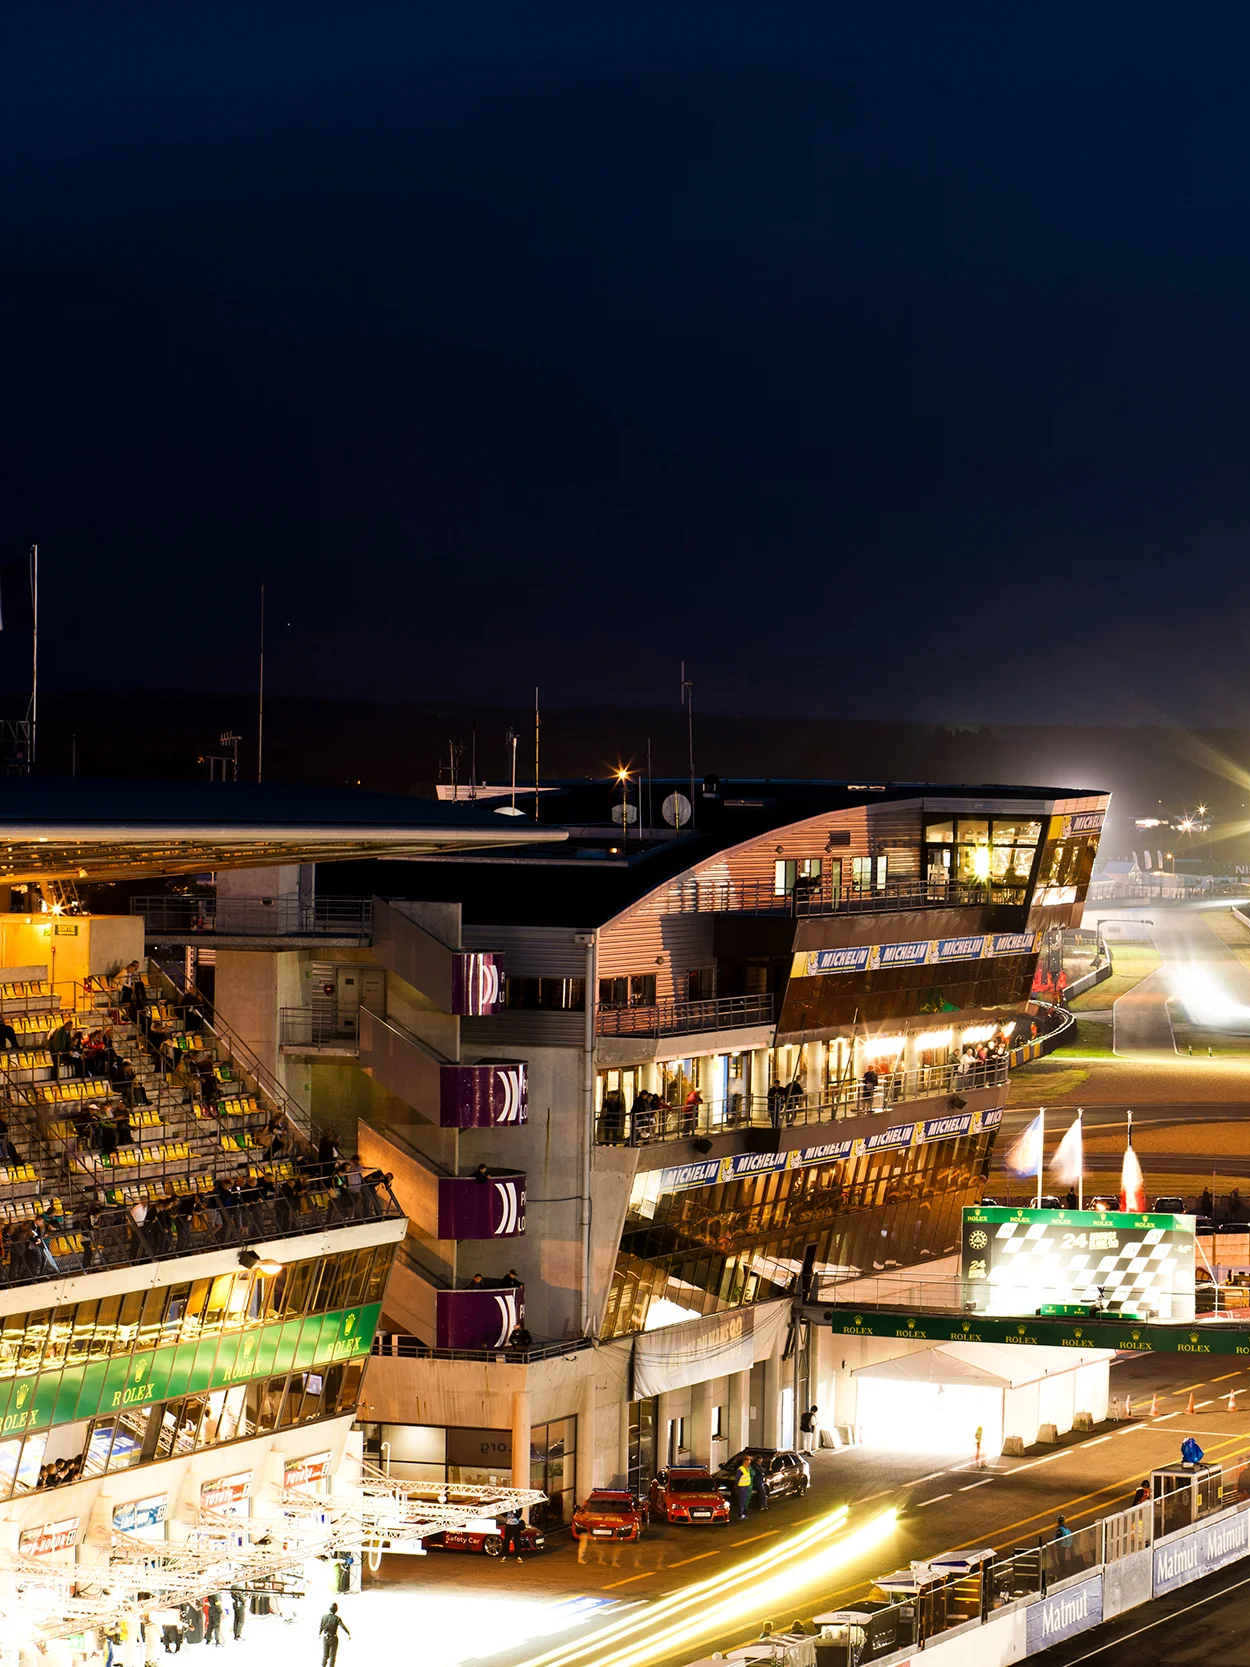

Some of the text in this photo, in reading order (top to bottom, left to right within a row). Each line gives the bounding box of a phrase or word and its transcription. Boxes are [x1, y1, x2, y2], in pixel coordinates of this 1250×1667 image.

[1073, 813, 1105, 830] MICHELI
[941, 938, 983, 955] MICHELIN
[996, 934, 1035, 950] MICHELIN
[821, 949, 866, 967] MICHELIN
[883, 944, 927, 961] MICHELIN
[928, 1116, 971, 1136] MICHELIN
[868, 1127, 913, 1148] MICHELIN
[804, 1140, 851, 1160] MICHELIN
[737, 1152, 787, 1173] MICHELIN
[664, 1163, 719, 1185] MICHELIN
[1060, 1232, 1088, 1249] 24
[969, 1259, 987, 1270] 24
[843, 1326, 873, 1335] ROLEX
[896, 1329, 927, 1339] ROLEX
[950, 1332, 982, 1342] ROLEX
[326, 1337, 362, 1357] ROLEX
[1005, 1336, 1038, 1345] ROLEX
[1061, 1339, 1095, 1348] ROLEX
[1119, 1341, 1152, 1350] ROLEX
[1177, 1344, 1211, 1353] ROLEX
[223, 1360, 260, 1381] ROLEX
[111, 1383, 155, 1406] ROLEX
[286, 1468, 313, 1485] TOYOTA
[445, 1535, 467, 1544] Safety
[1207, 1519, 1245, 1560] Matmut
[1157, 1540, 1198, 1583] Matmut
[1042, 1589, 1088, 1638] Matmut
